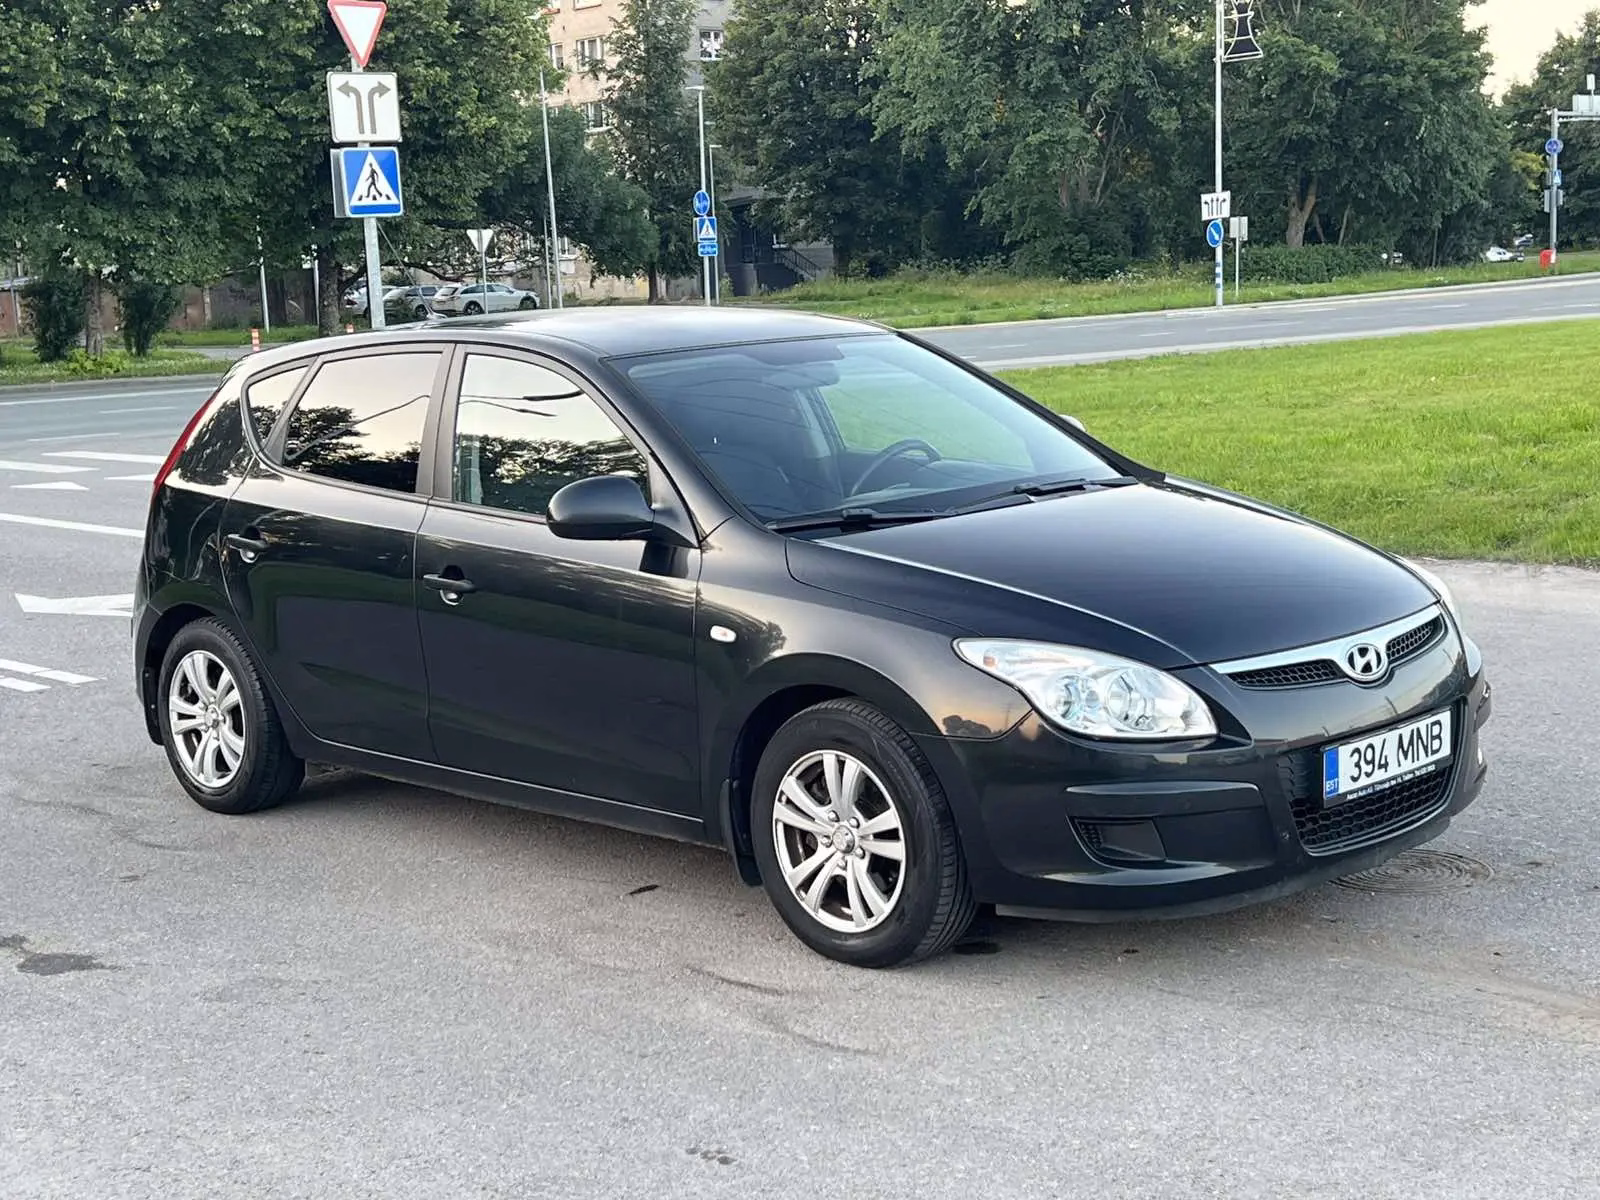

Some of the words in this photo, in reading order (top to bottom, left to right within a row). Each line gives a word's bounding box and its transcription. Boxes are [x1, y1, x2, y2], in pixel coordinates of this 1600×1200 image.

[1350, 739, 1389, 783] 394
[1397, 720, 1443, 767] MNB
[1326, 778, 1338, 791] EST
